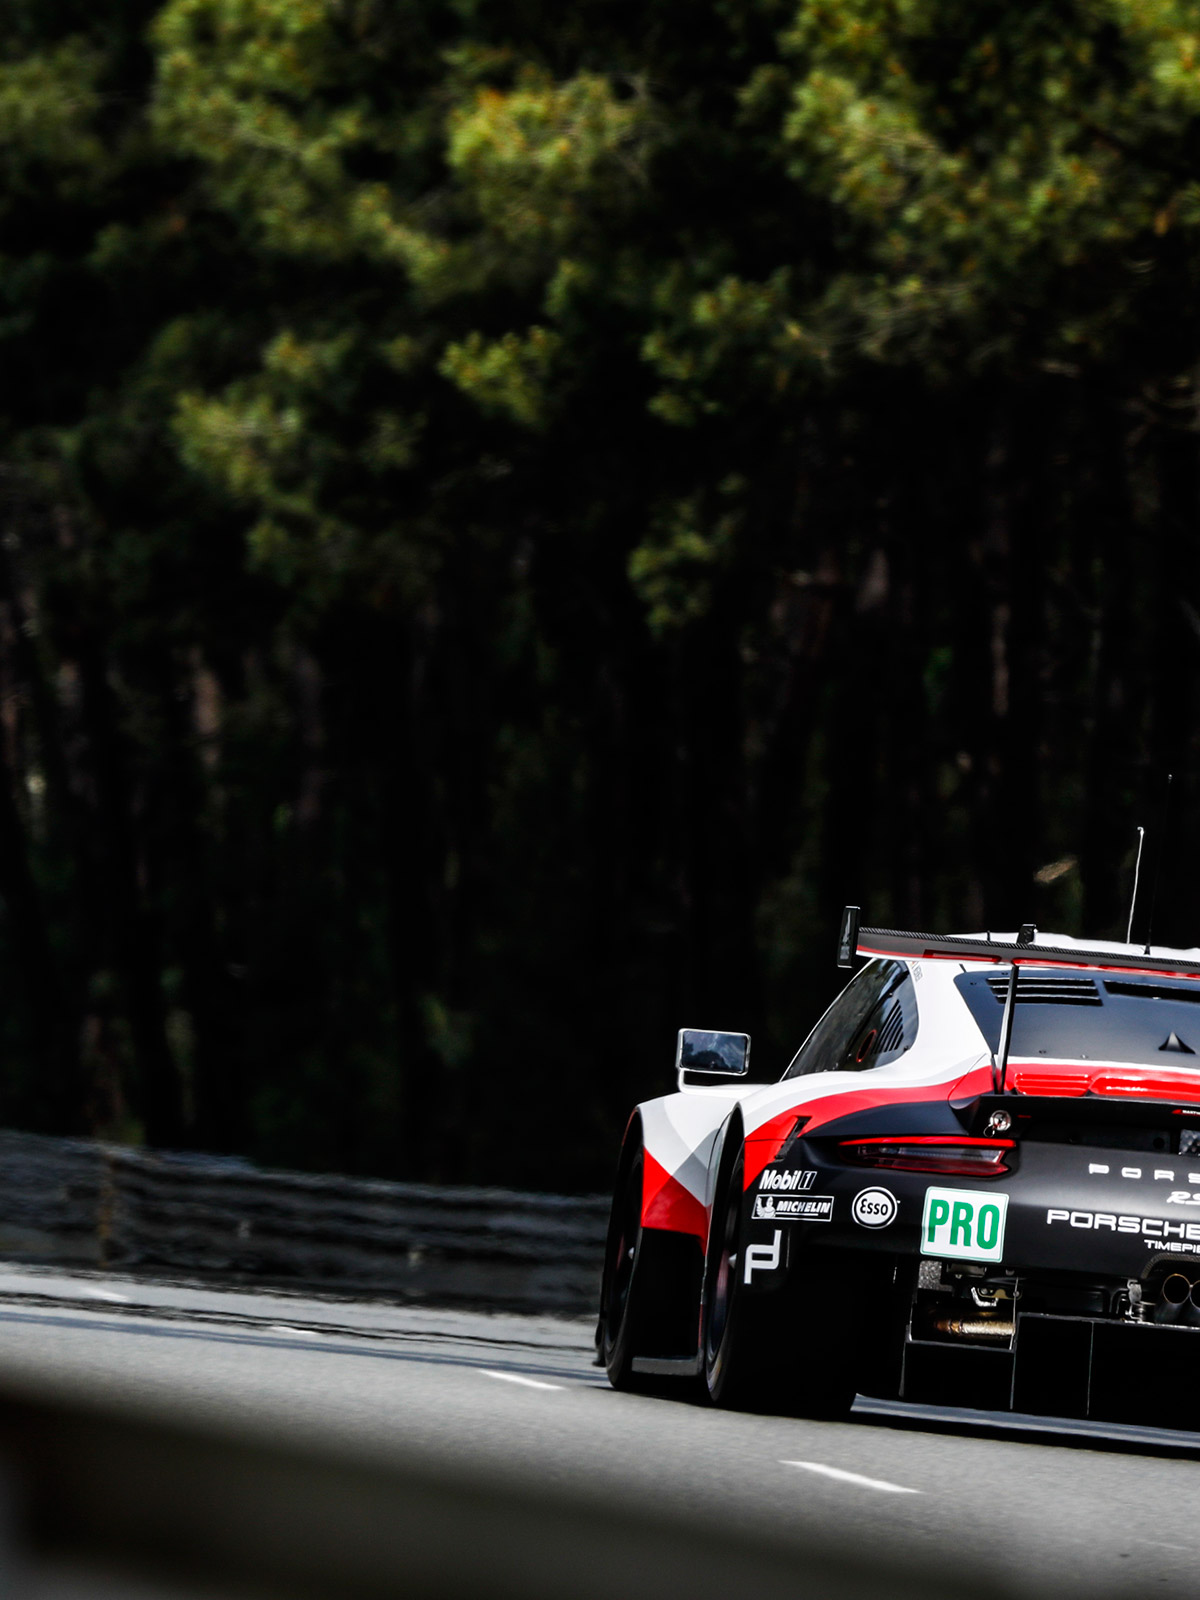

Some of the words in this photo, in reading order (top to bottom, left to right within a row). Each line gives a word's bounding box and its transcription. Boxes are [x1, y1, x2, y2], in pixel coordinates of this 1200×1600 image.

[758, 1169, 802, 1190] Mobil
[776, 1200, 831, 1214] MICHELIN
[927, 1199, 1000, 1250] PRO
